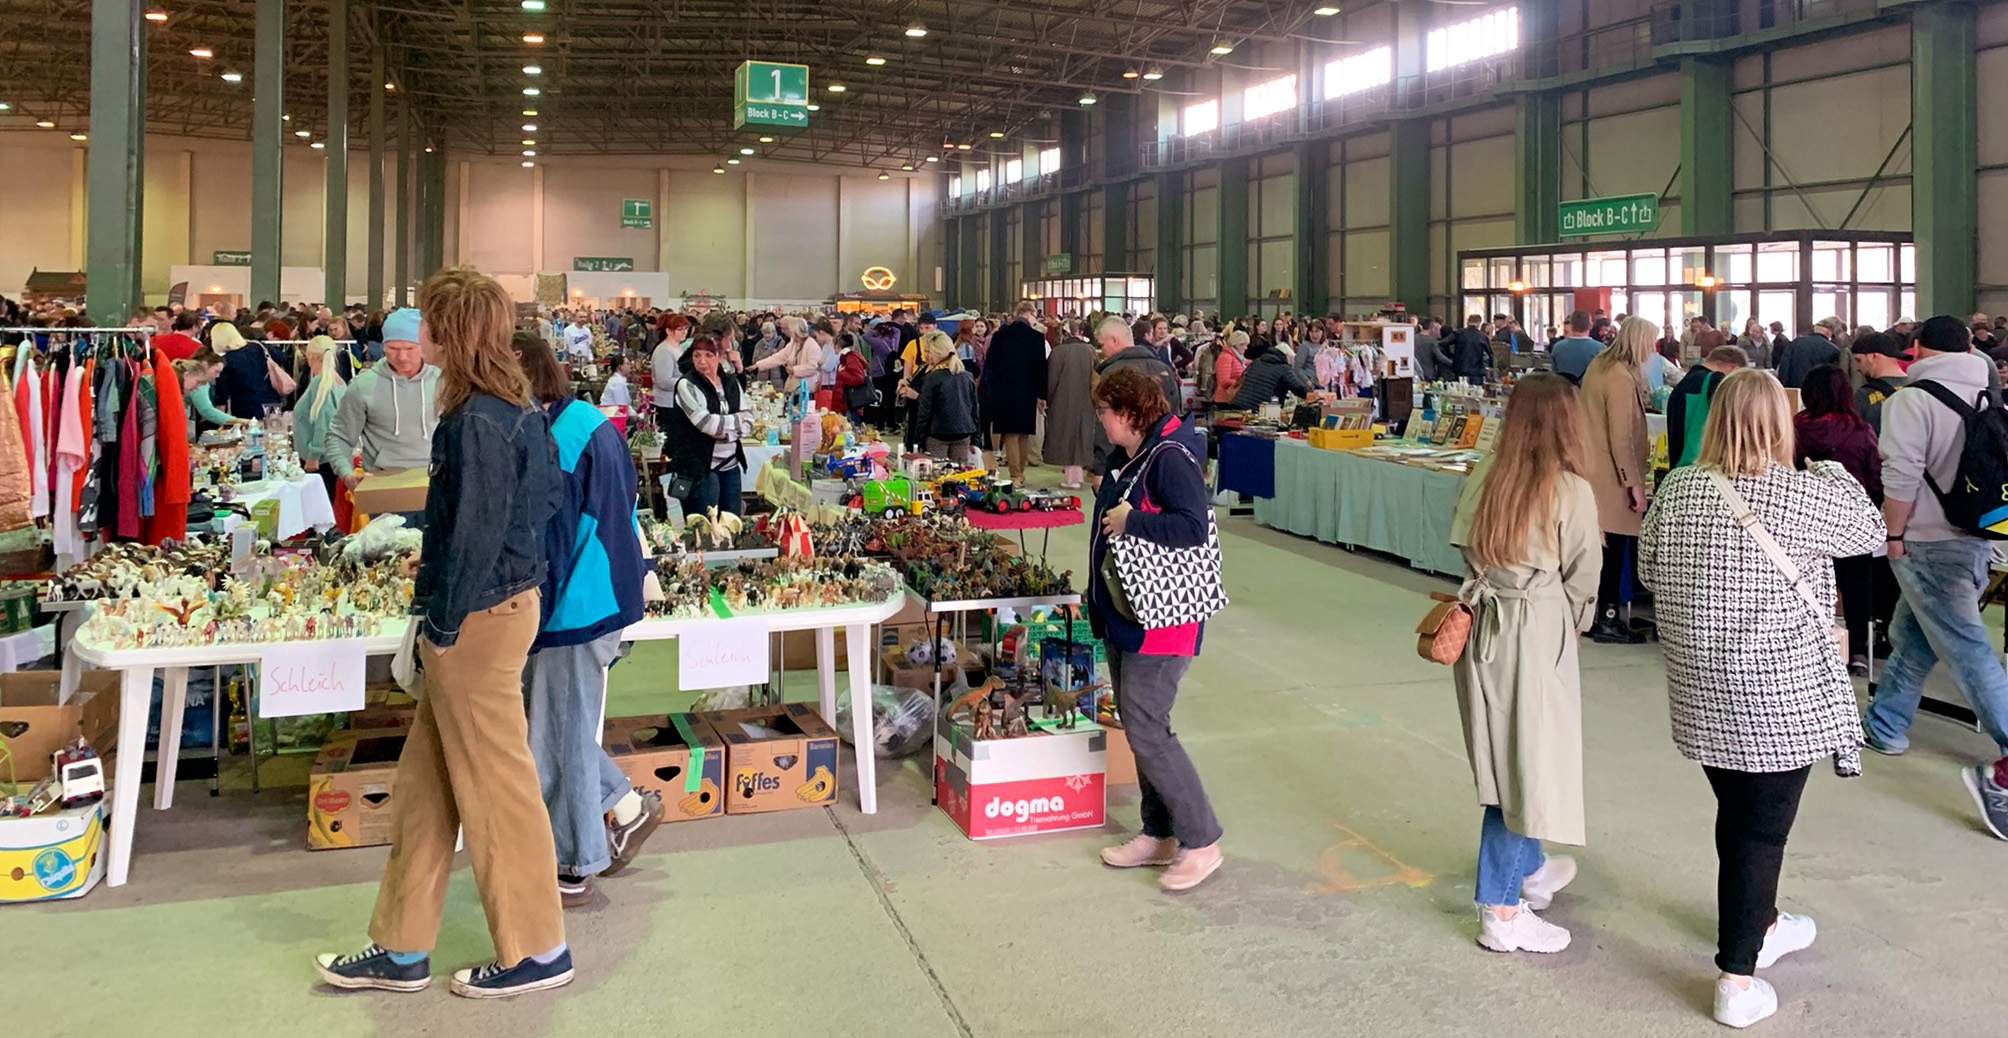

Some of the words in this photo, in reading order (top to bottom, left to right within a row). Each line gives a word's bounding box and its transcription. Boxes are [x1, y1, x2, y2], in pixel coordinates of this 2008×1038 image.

[771, 69, 781, 98] 1
[747, 107, 770, 118] Block
[1577, 209, 1604, 228] Block
[687, 641, 750, 669] Schleich
[270, 662, 344, 695] Schleich
[985, 796, 1064, 823] dogma
[1030, 814, 1070, 824] Tiernahrung
[1070, 810, 1094, 820] GmbH
